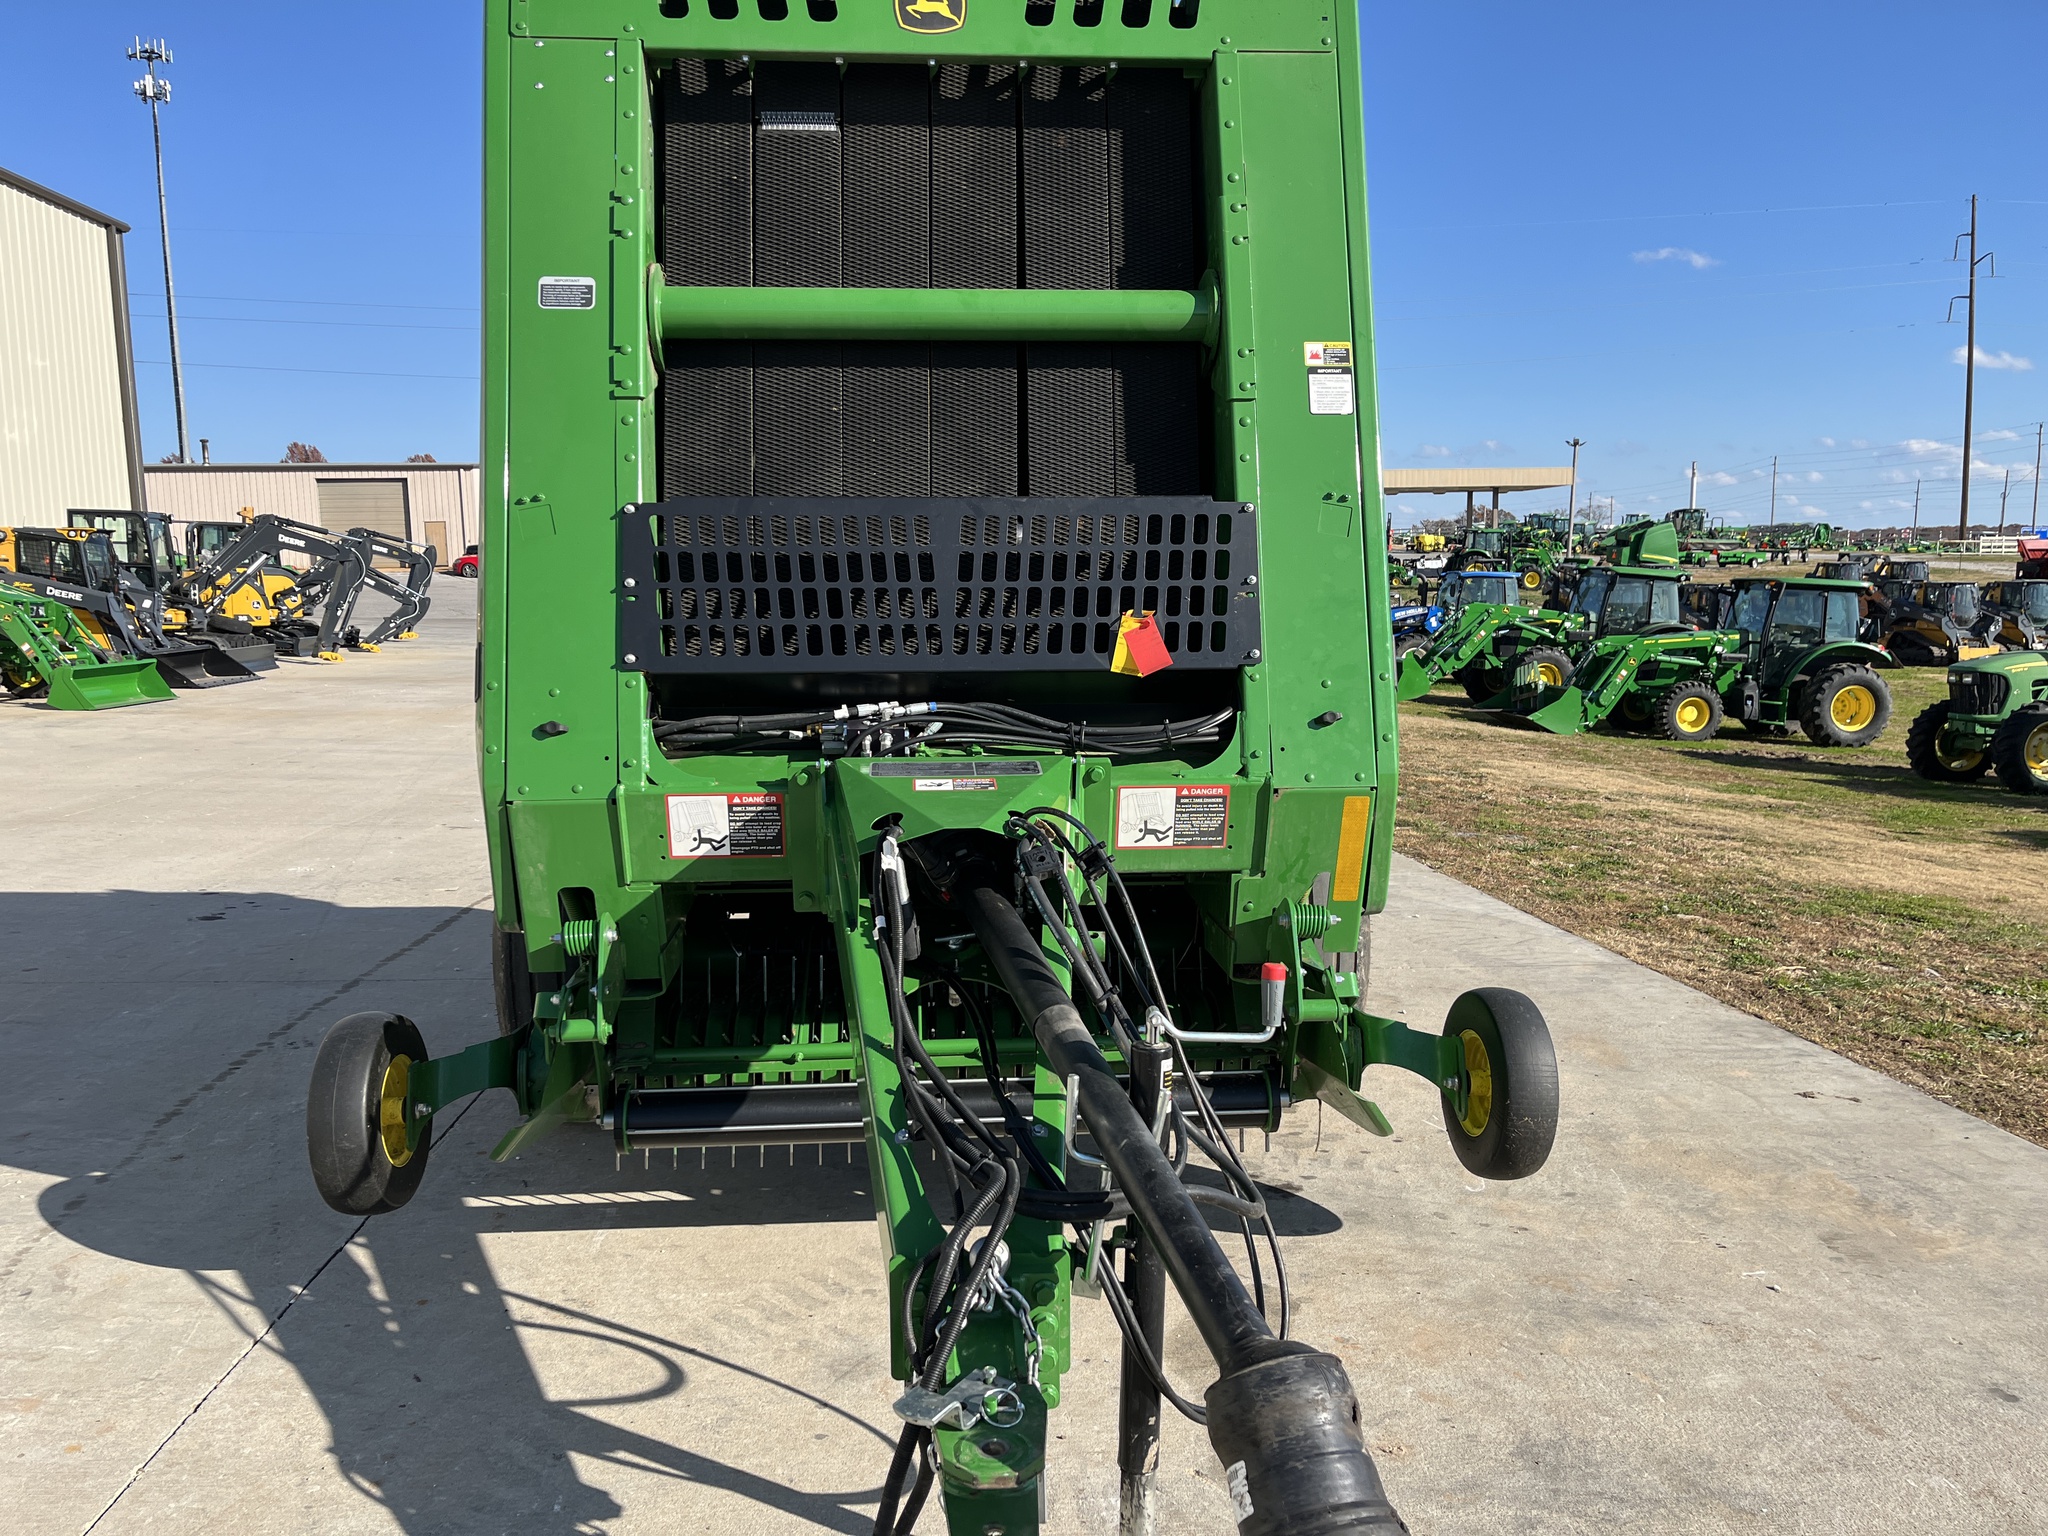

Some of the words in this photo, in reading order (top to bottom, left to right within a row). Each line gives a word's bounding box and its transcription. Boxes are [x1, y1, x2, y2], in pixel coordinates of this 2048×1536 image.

[278, 533, 306, 548] DEERE
[46, 586, 83, 601] DEERE
[1686, 613, 1698, 624] DEERE
